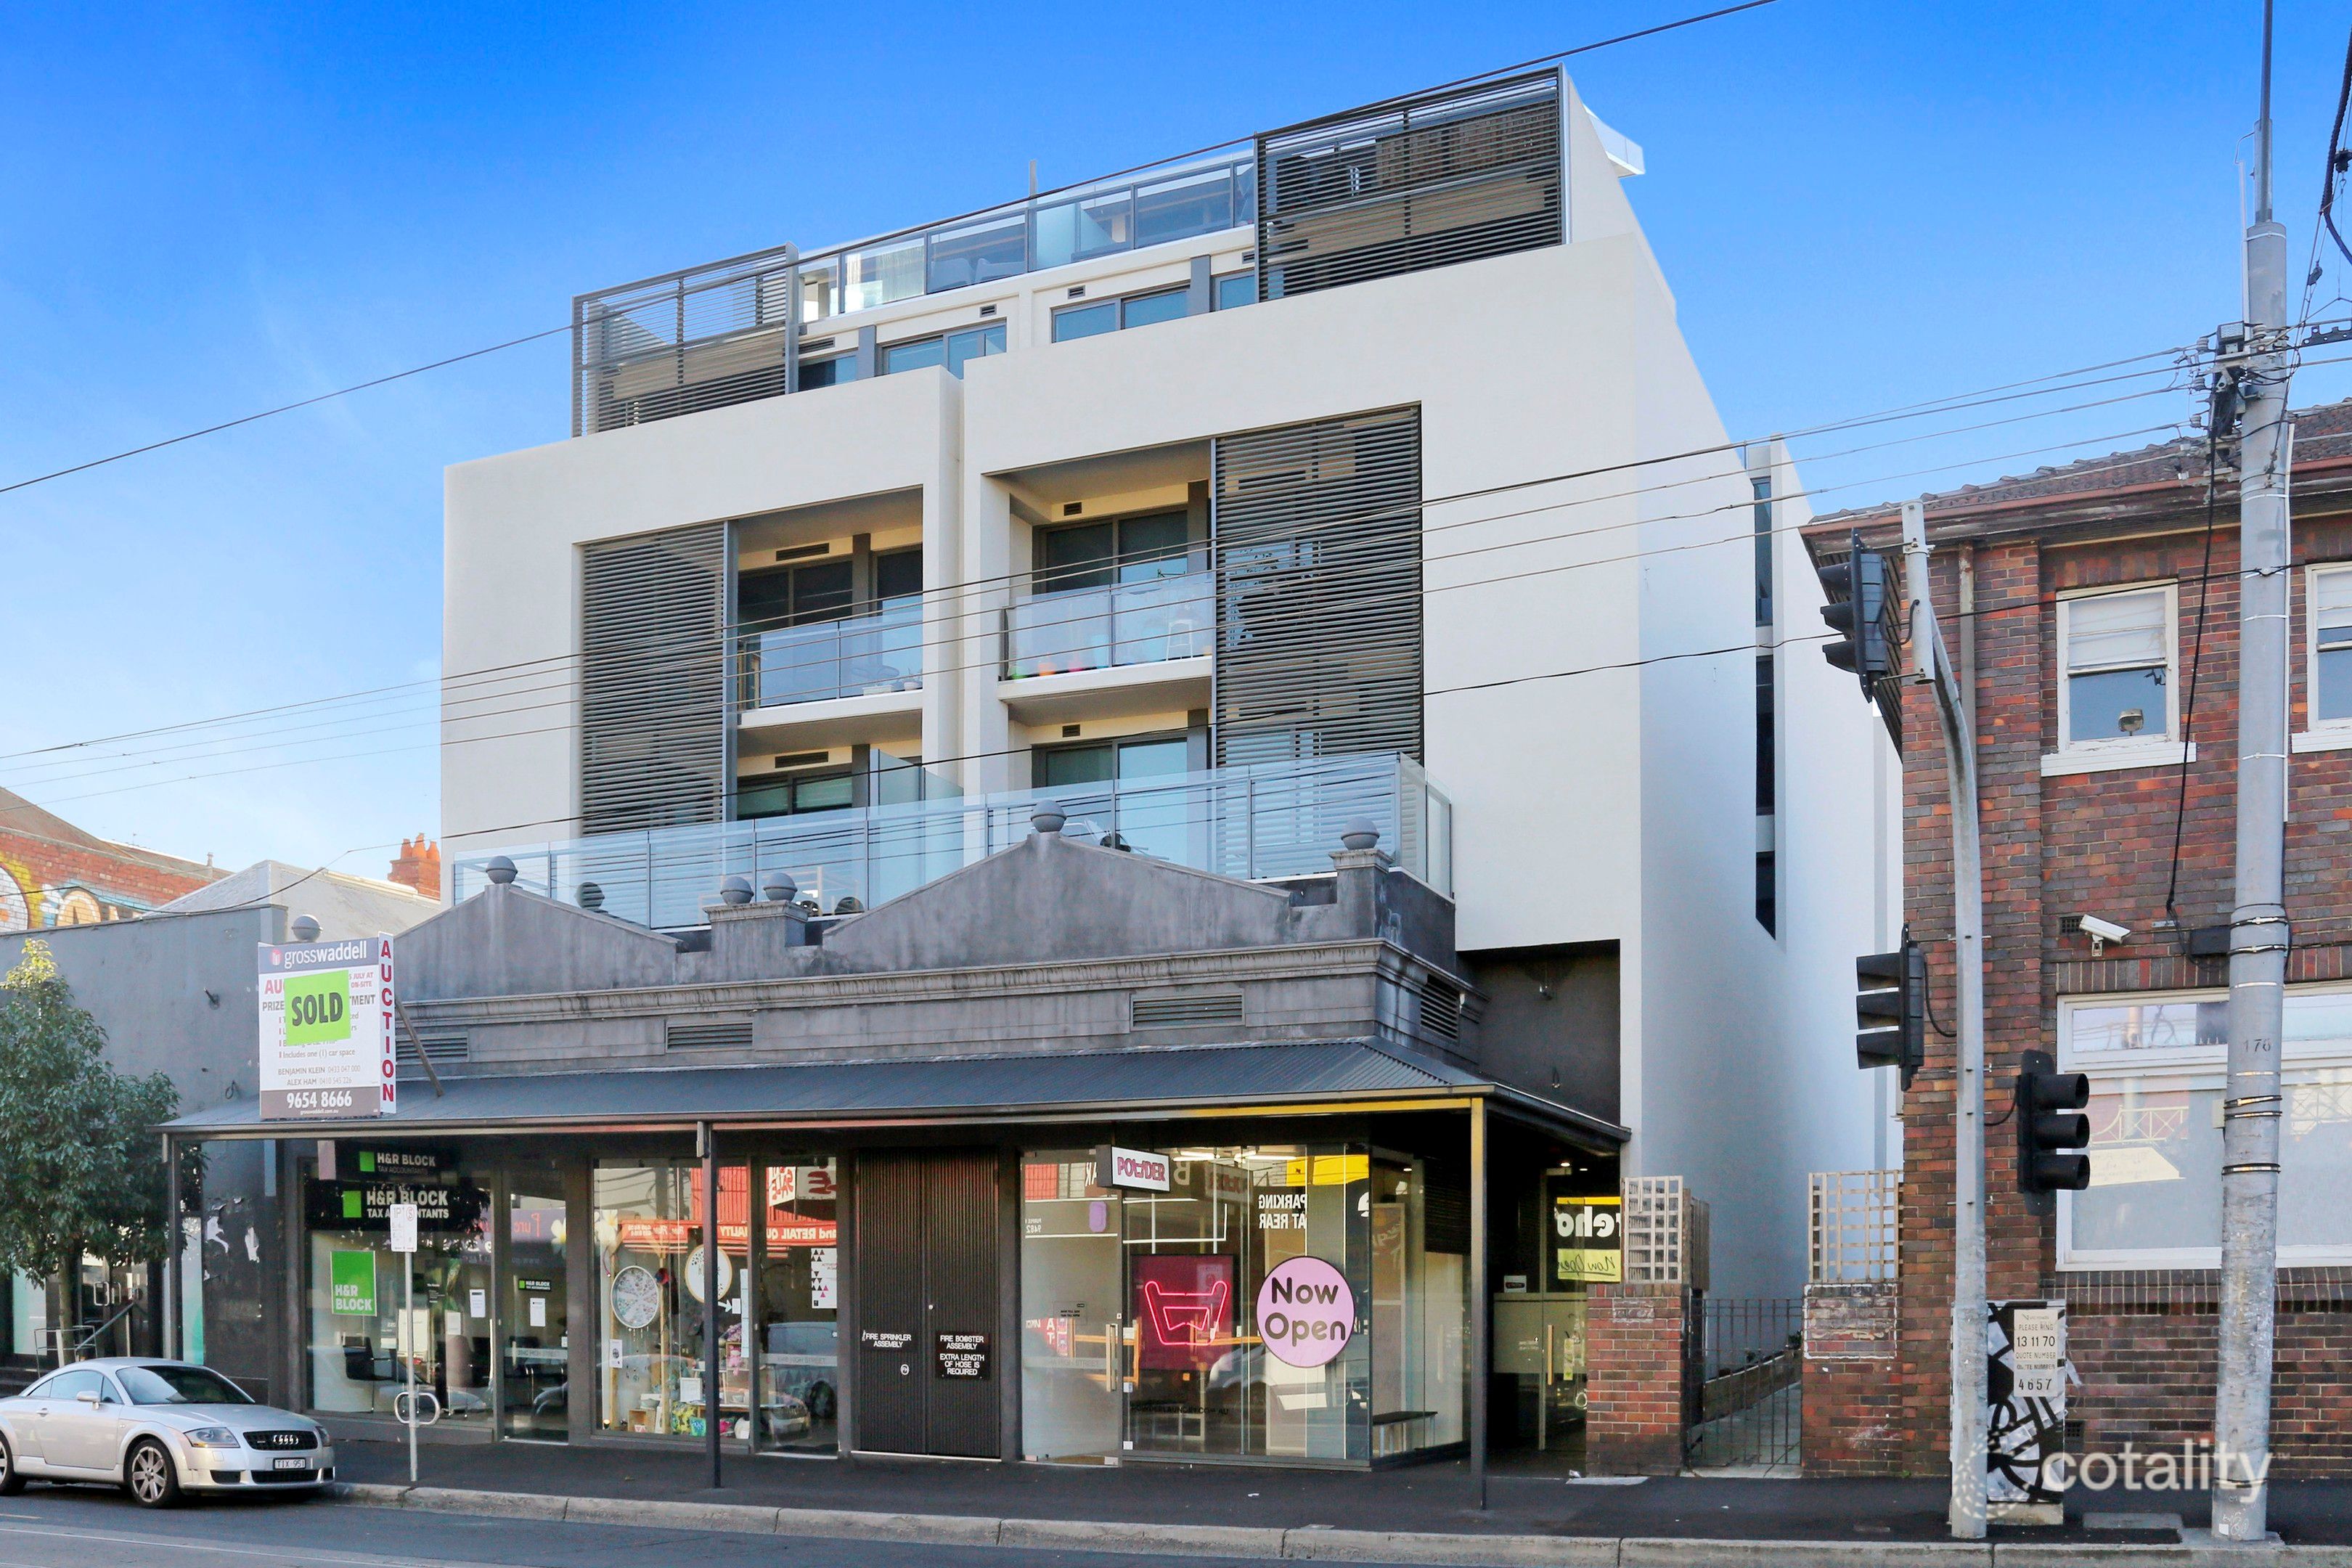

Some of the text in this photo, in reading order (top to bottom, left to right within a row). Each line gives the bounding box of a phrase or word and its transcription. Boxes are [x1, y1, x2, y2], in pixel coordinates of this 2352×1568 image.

[284, 940, 367, 968] grosswaddell
[291, 992, 343, 1026] SOLD
[380, 940, 394, 1102] AUCTION
[339, 1049, 355, 1058] space
[286, 1090, 352, 1108] 9654 8666
[377, 1152, 436, 1167] H&R BLOCK
[366, 1191, 448, 1206] H&R BLOCK
[367, 1208, 449, 1219] TAX ANTANTS
[335, 1284, 358, 1297] H&R
[1271, 1276, 1339, 1304] Now
[335, 1297, 372, 1311] BLOCK
[1265, 1312, 1345, 1347] Open
[2017, 1336, 2055, 1347] 13 11 70
